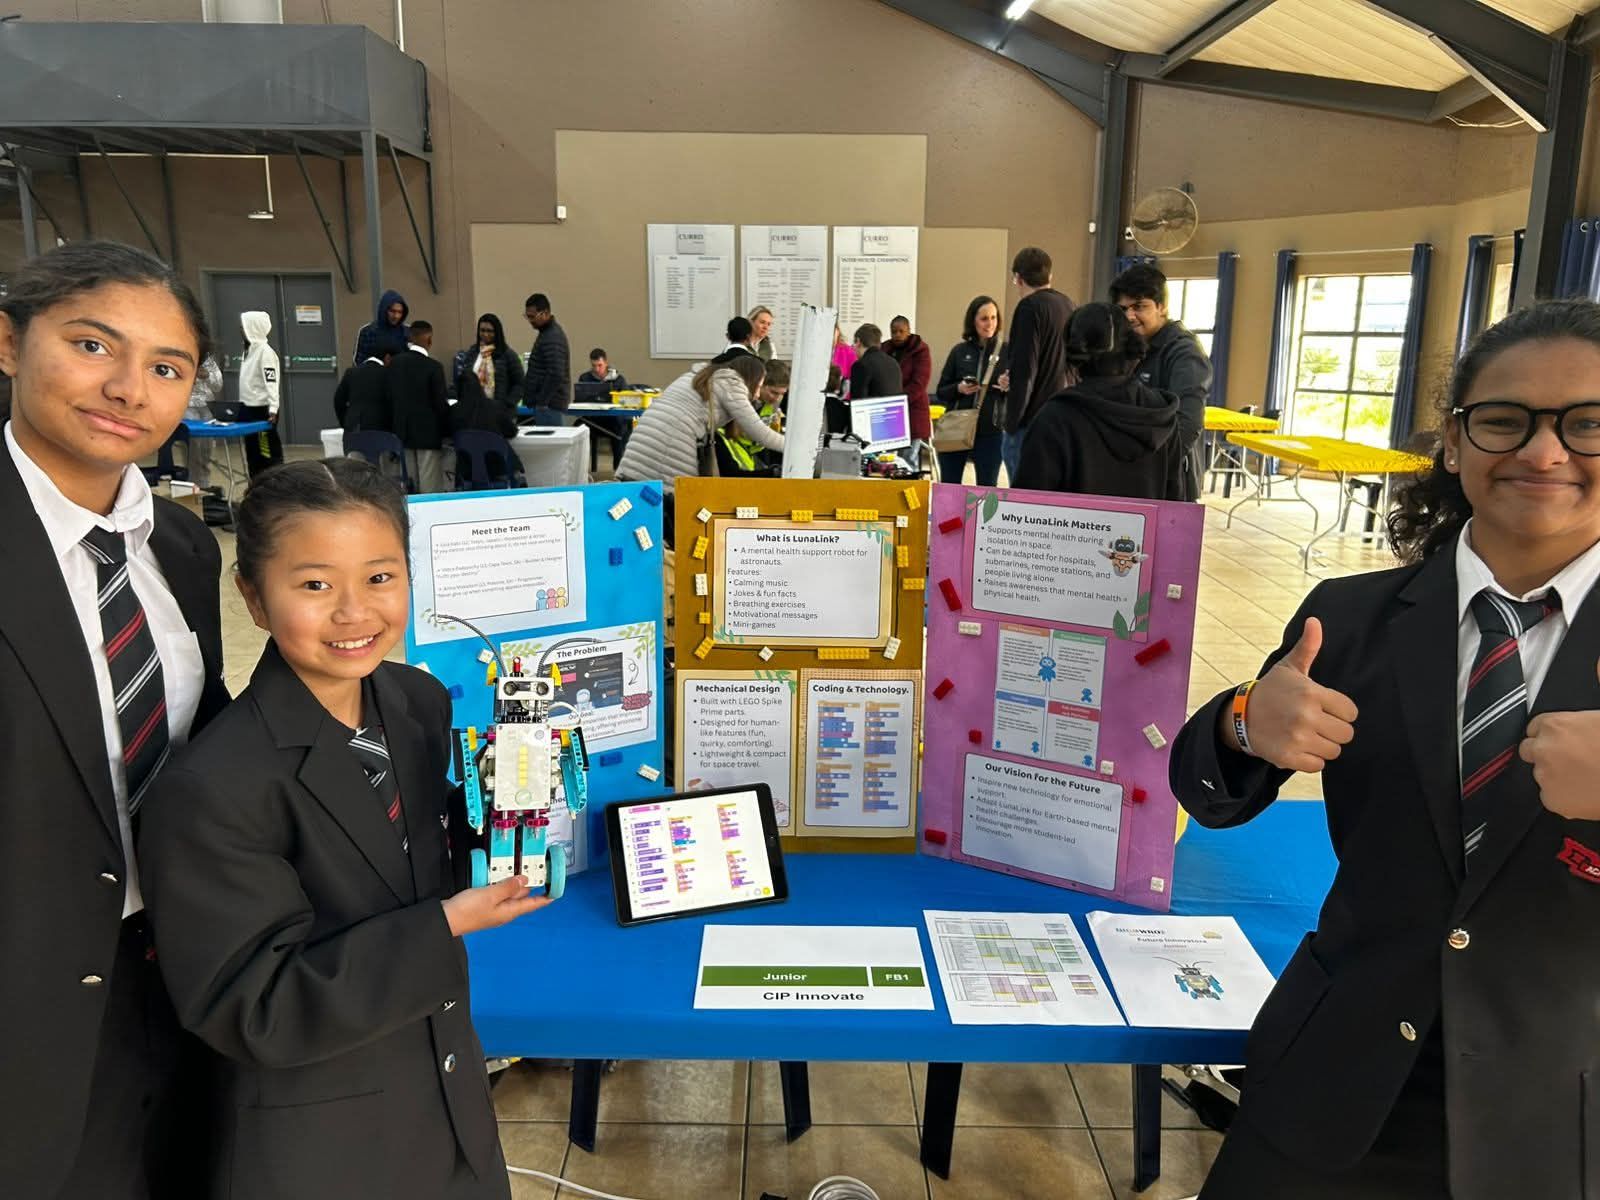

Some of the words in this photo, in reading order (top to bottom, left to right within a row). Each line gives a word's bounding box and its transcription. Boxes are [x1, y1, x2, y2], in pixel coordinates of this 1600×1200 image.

[1001, 513, 1022, 524] Why
[1025, 515, 1068, 528] LunaLink
[1071, 520, 1112, 532] Matters
[793, 535, 839, 543] LunaLink?
[987, 536, 1018, 546] isolation
[1029, 542, 1052, 550] space.
[988, 526, 1021, 536] Supports
[1023, 529, 1049, 539] mental
[1051, 532, 1076, 542] health
[1077, 534, 1104, 546] during
[986, 547, 1001, 555] Can
[1013, 550, 1045, 561] adapted
[1059, 555, 1097, 568] hospitals,
[984, 569, 1010, 579] people
[1011, 571, 1031, 582] living
[985, 558, 1030, 570] submarines,
[1031, 564, 1059, 573] remote
[1060, 565, 1094, 578] stations,
[1095, 570, 1111, 579] and
[733, 579, 764, 588] Calming
[984, 578, 1007, 588] Raises
[1009, 583, 1048, 593] awareness
[1050, 586, 1065, 595] that
[1066, 589, 1093, 599] mental
[1095, 593, 1121, 602] health
[984, 589, 1014, 600] physical
[1015, 592, 1040, 603] health.
[733, 601, 769, 609] Breathing
[557, 650, 572, 658] The
[574, 646, 607, 657] Problem
[749, 686, 780, 694] Design
[813, 684, 844, 694] Coding
[855, 686, 909, 694] Technology.
[985, 763, 1002, 773] Our
[1004, 766, 1032, 780] Vision
[1034, 773, 1049, 784] for
[1050, 776, 1067, 787] the
[1068, 781, 1101, 794] Future
[977, 787, 1006, 799] support.
[978, 776, 1002, 788] Inspire
[1003, 782, 1017, 791] new
[1019, 784, 1060, 800] technology
[1061, 794, 1072, 803] for
[1073, 798, 1112, 812] emotional
[976, 796, 997, 808] Adapt
[999, 801, 1031, 815] LunaLink
[1032, 808, 1043, 818] for
[1044, 811, 1089, 828] Earth-based
[1091, 821, 1118, 834] mental
[976, 805, 998, 816] health
[999, 810, 1038, 826] challenges.
[976, 815, 1012, 830] Encourage
[1013, 824, 1033, 834] more
[1034, 827, 1076, 845] student-led
[976, 825, 1013, 839] innovation.
[762, 973, 807, 981] Junior
[763, 992, 790, 1001] CIP
[795, 992, 864, 1001] Innovate
